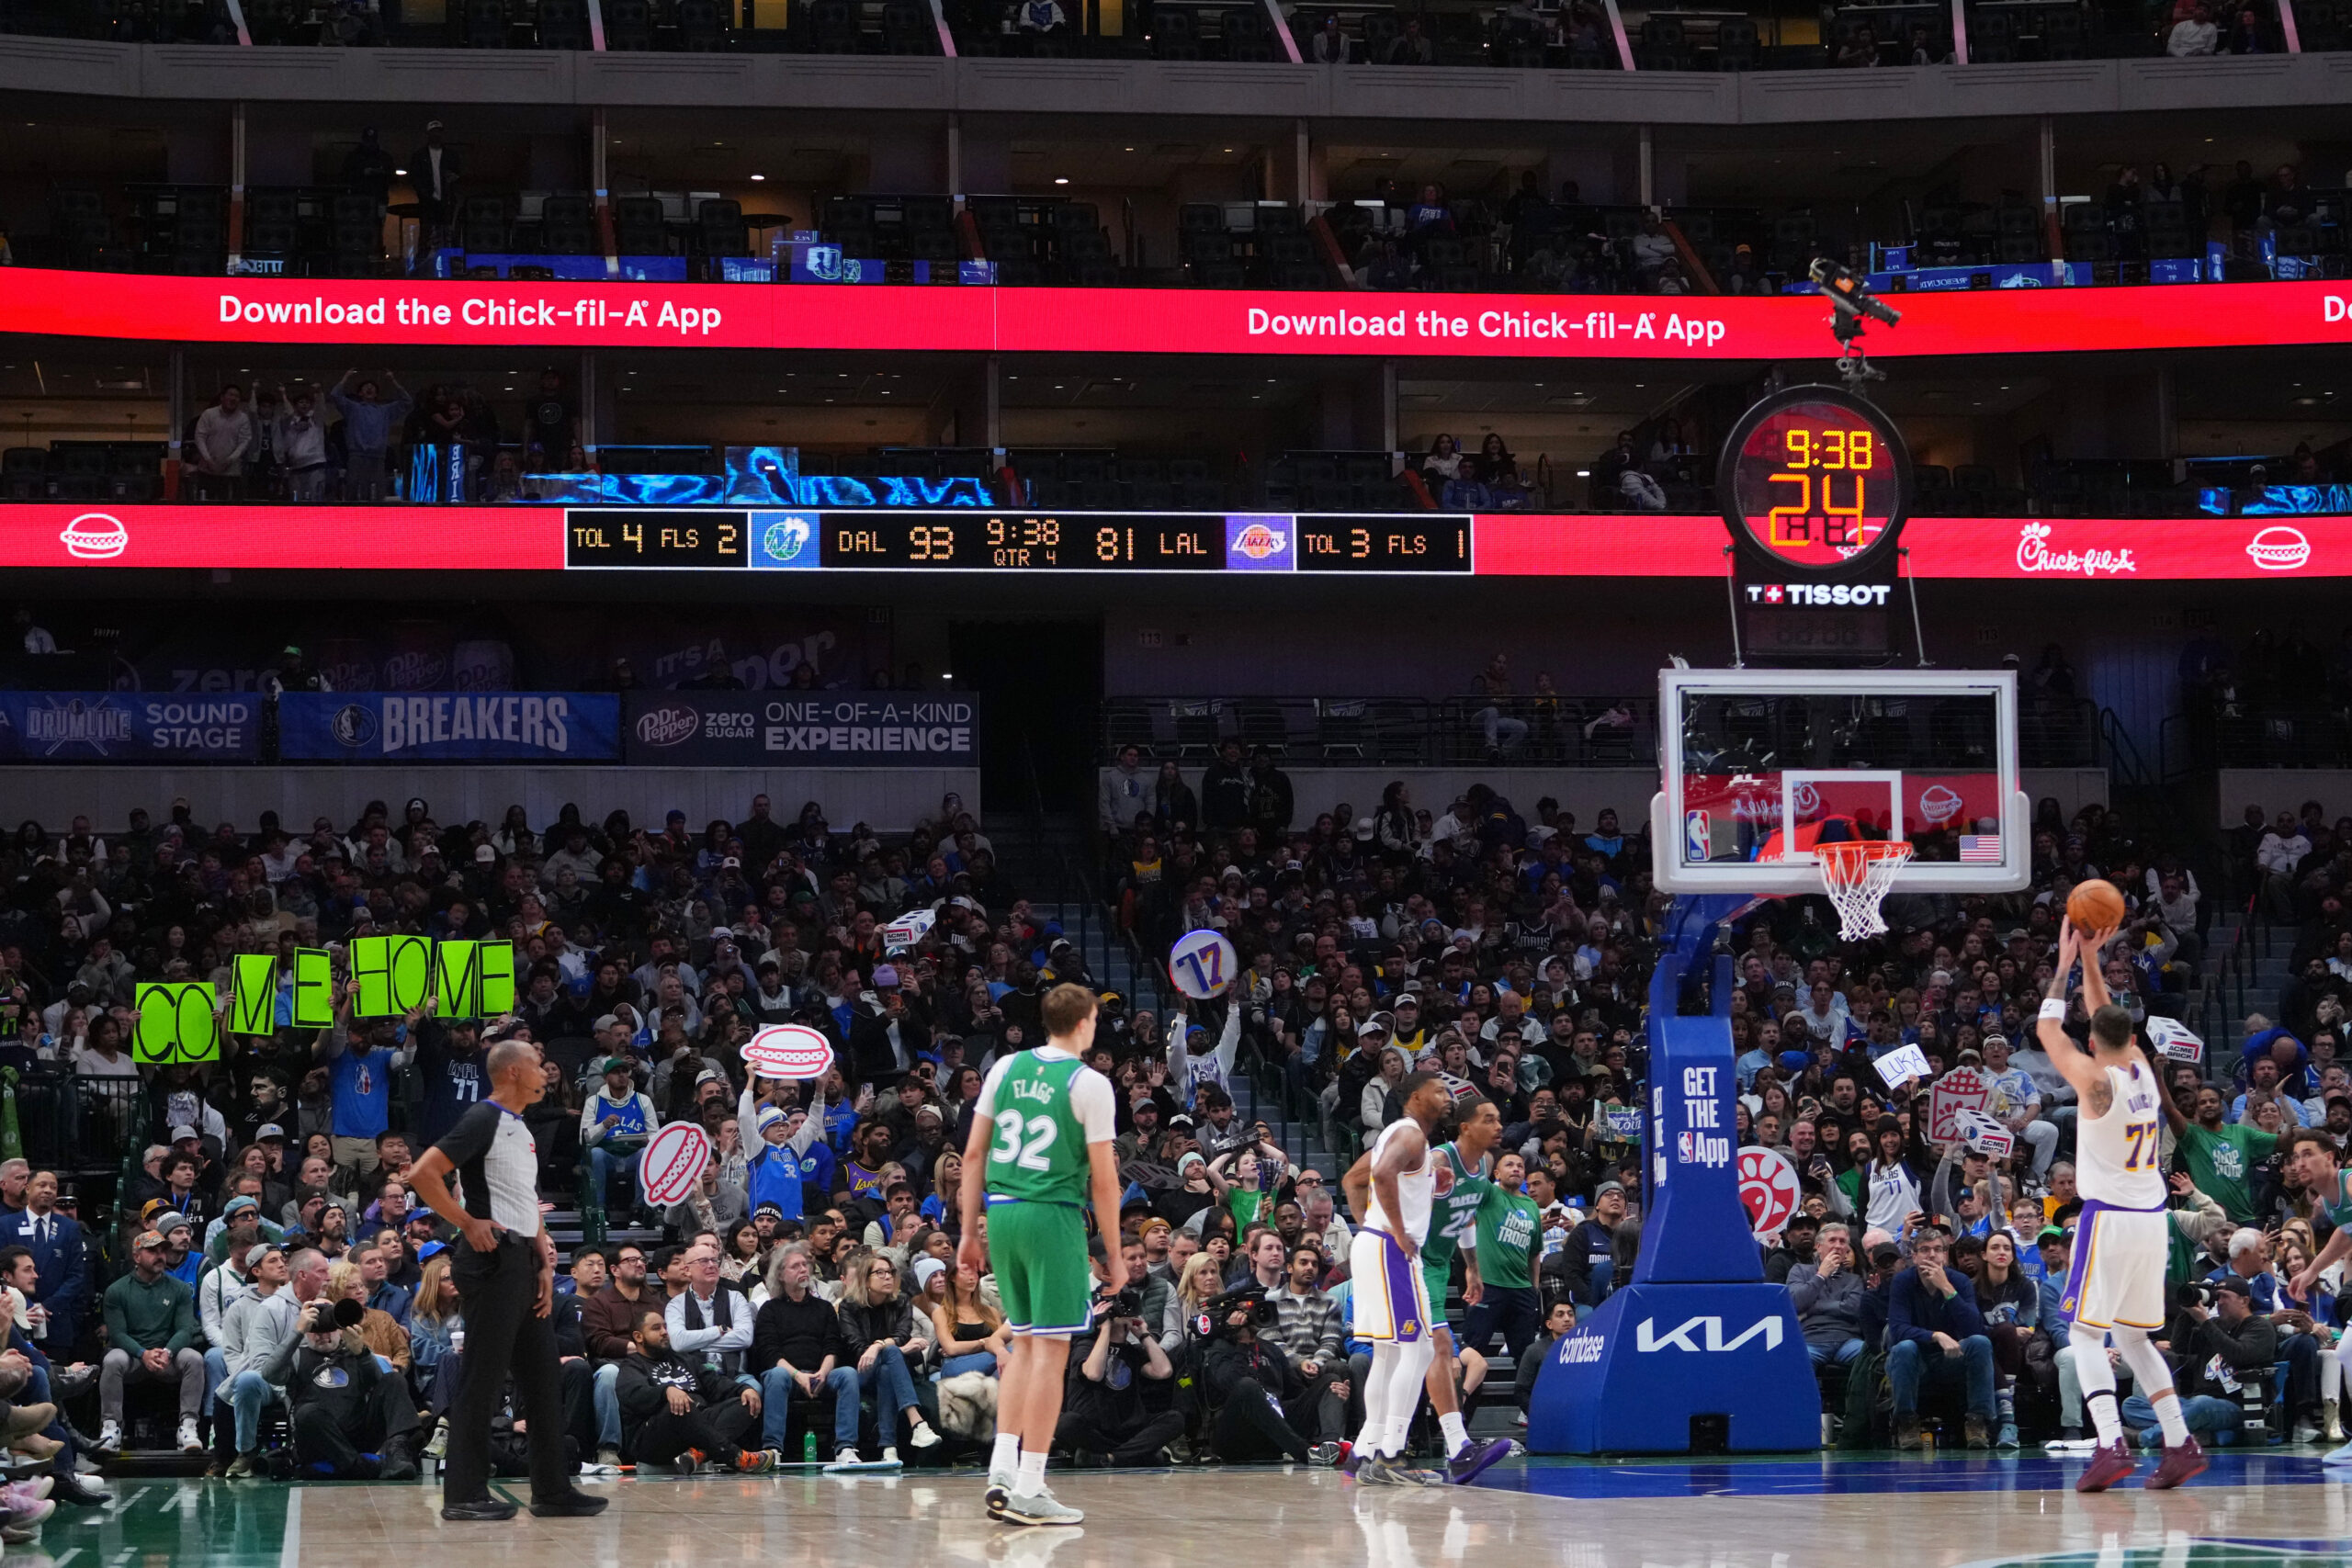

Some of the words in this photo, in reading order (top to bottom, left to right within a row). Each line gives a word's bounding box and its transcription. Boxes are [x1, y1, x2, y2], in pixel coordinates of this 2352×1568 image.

[220, 295, 385, 324] Download
[396, 298, 451, 325] the
[658, 300, 722, 333] App
[1249, 309, 1405, 336] Download
[1416, 310, 1468, 337] the
[1664, 314, 1725, 345] App
[1787, 430, 1871, 469] 9:38
[1769, 473, 1864, 546] 24
[573, 527, 610, 547] TOL
[623, 524, 642, 553] 4
[661, 528, 698, 547] FLS
[718, 525, 737, 554] 2
[839, 531, 886, 552] DAL
[910, 526, 954, 559] 93
[987, 519, 1059, 546] 9:38
[1097, 527, 1133, 560] 81
[1159, 533, 1206, 554] LAL
[1232, 533, 1285, 551] LAKERS
[1305, 534, 1340, 554] TOL
[1351, 529, 1370, 558] 3
[1388, 535, 1427, 554] FLS
[1458, 530, 1463, 558] 1
[993, 549, 1029, 566] QTR
[1046, 550, 1057, 565] 4
[1786, 585, 1891, 604] TISSOT
[1140, 632, 1161, 644] 113
[656, 645, 702, 678] IT'S
[706, 637, 726, 661] A
[28, 706, 130, 740] DRUMLINE
[146, 703, 248, 724] SOUND
[382, 696, 568, 752] BREAKERS
[659, 708, 680, 727] Dr
[706, 712, 754, 727] zero
[765, 702, 972, 723] ONE-OF-A-KIND
[153, 728, 241, 749] STAGE
[640, 713, 695, 742] Pepper
[706, 728, 754, 738] SUGAR
[765, 727, 971, 750] EXPERIENCE
[352, 937, 513, 1017] HOME
[1176, 942, 1225, 992] 77
[2166, 1051, 2193, 1060] BRICK
[2168, 1045, 2194, 1055] ACME
[1878, 1050, 1928, 1082] LUKA
[453, 1077, 479, 1102] 77
[1012, 1078, 1055, 1104] FLAGG
[1684, 1067, 1717, 1096] GET
[1684, 1099, 1720, 1128] THE
[992, 1109, 1057, 1171] 32
[1695, 1132, 1729, 1168] App
[1981, 1139, 2006, 1148] ACME
[2125, 1121, 2157, 1172] 77
[2212, 1149, 2239, 1163] HOOP
[1871, 1168, 1899, 1184] DALLAS
[1885, 1179, 1902, 1195] 77
[1498, 1225, 1532, 1250] TROOP
[1504, 1212, 1534, 1235] HOOP
[1559, 1326, 1605, 1364] coinbase
[1636, 1316, 1783, 1352] KIA
